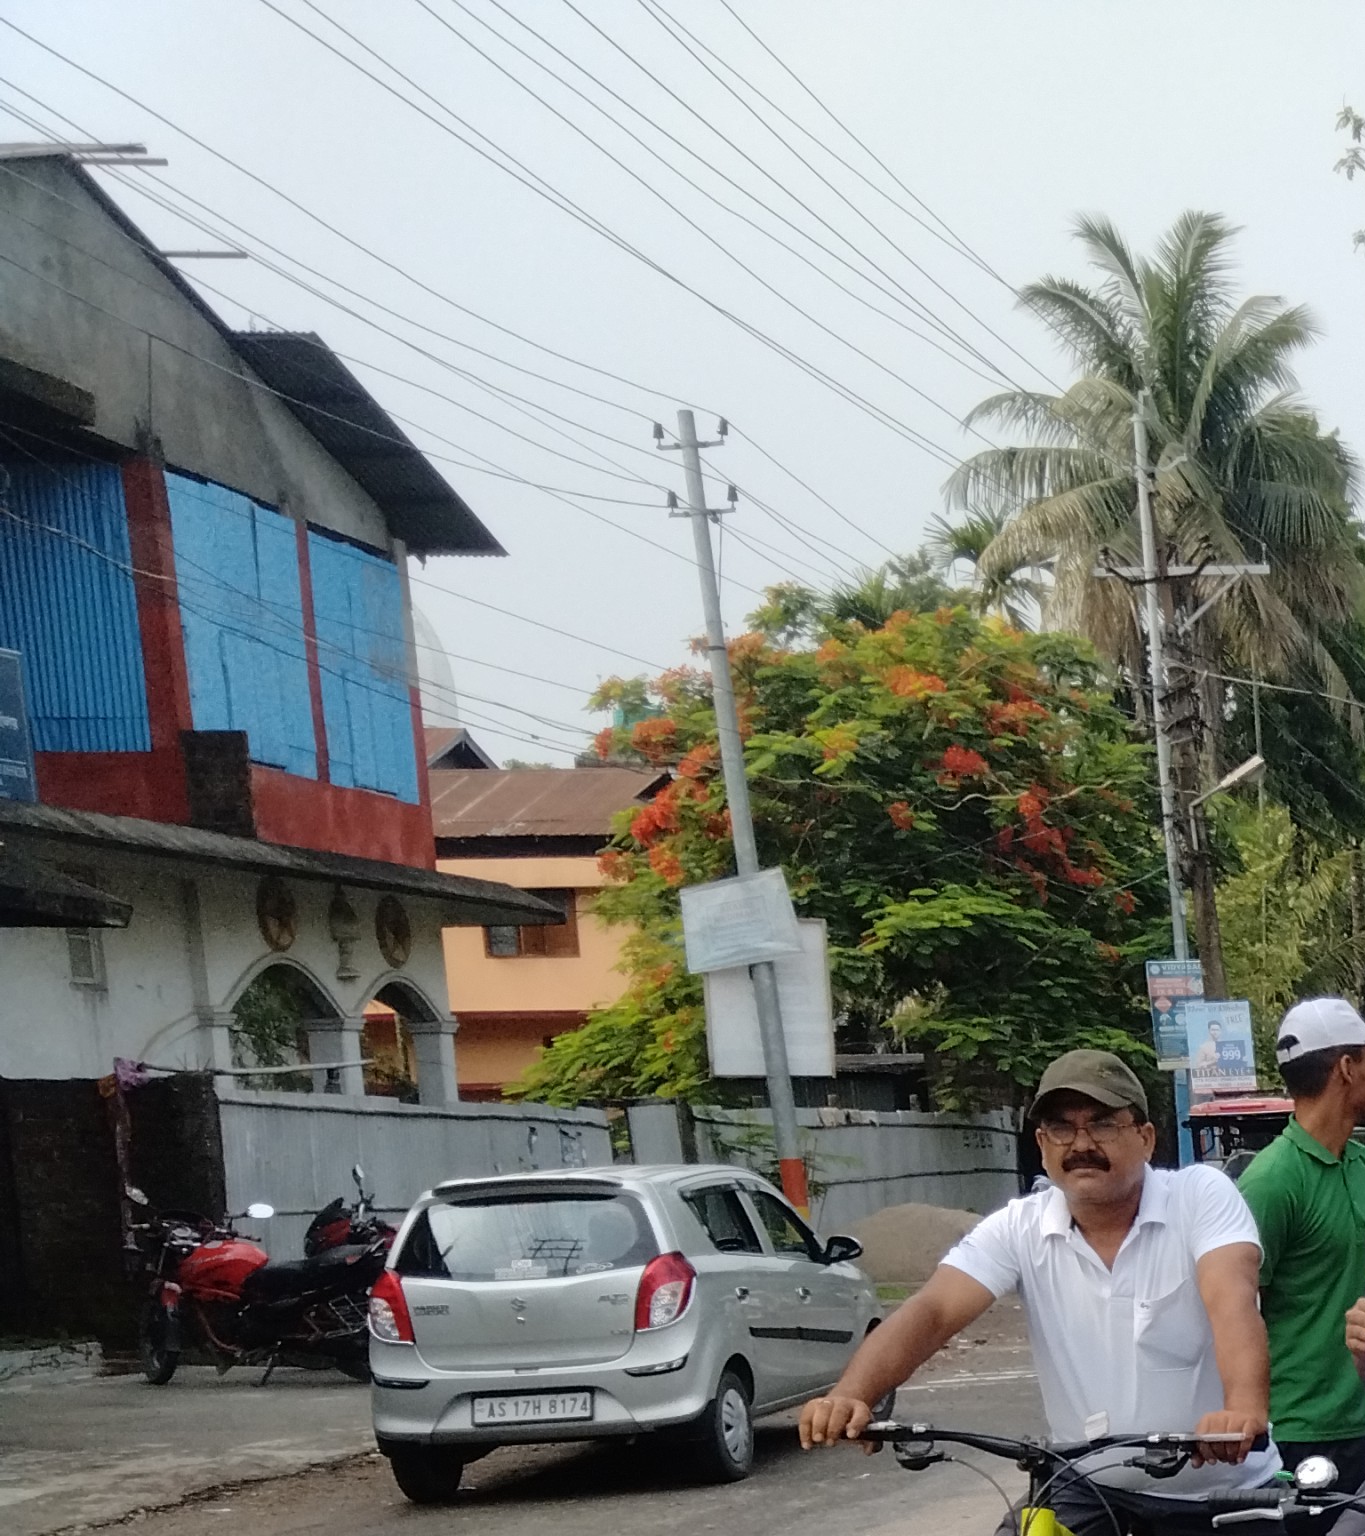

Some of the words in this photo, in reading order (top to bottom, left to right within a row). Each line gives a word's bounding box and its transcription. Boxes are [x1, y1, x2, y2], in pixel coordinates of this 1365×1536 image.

[1221, 1049, 1241, 1061] 999
[1195, 1068, 1226, 1078] TITAN
[487, 1402, 507, 1418] AS
[513, 1401, 542, 1417] 17H
[549, 1397, 588, 1414] 8174
